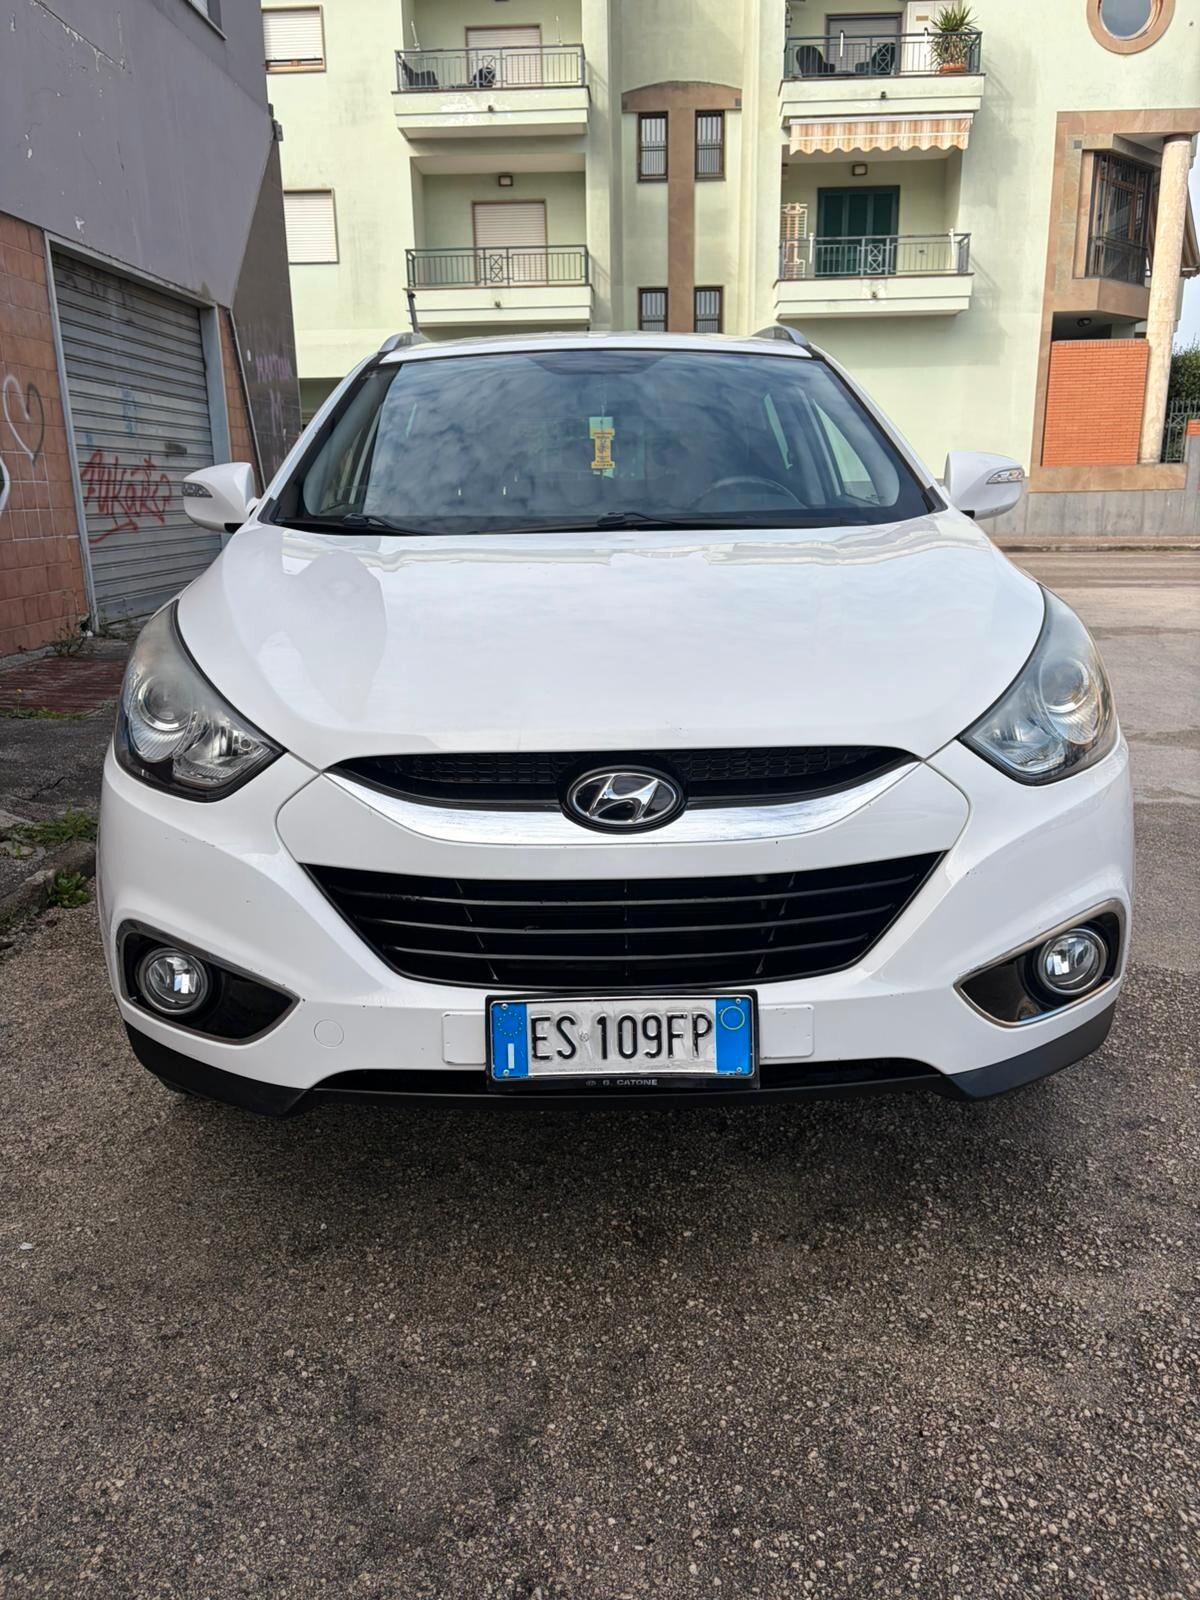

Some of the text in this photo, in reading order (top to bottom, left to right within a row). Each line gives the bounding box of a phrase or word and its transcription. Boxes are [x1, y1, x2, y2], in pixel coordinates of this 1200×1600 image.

[531, 1013, 713, 1060] ES 109FP
[508, 1043, 515, 1069] I
[617, 1079, 658, 1087] CATONE
